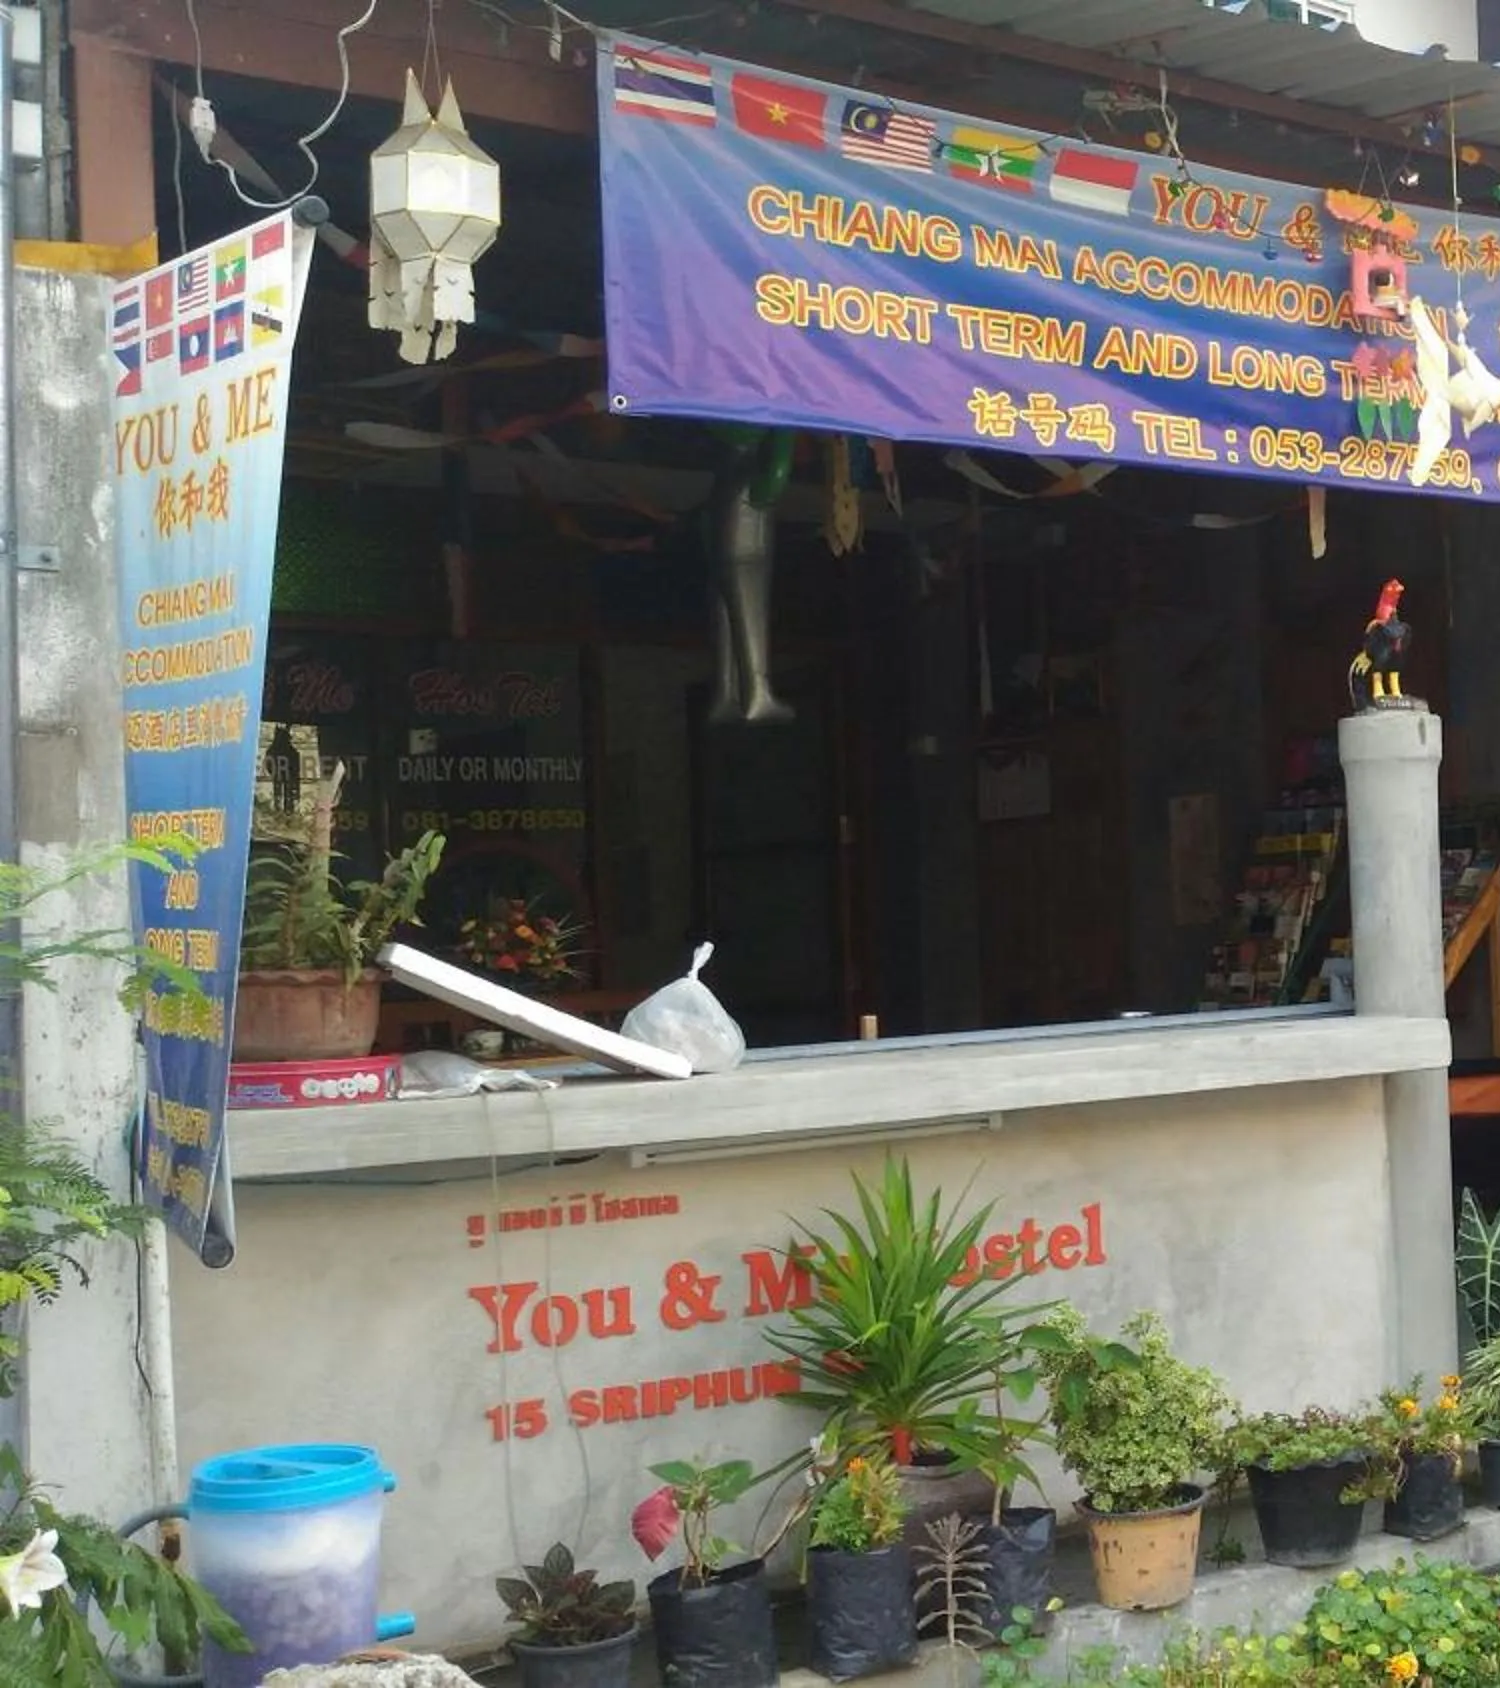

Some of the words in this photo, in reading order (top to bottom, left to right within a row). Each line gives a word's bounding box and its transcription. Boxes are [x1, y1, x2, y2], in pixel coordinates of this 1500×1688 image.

[748, 184, 962, 263] CHIANG
[970, 225, 1062, 280] MAI
[1151, 175, 1269, 241] YOU
[755, 273, 938, 343] SHORT
[947, 304, 1086, 367] TERM
[1094, 327, 1199, 379] AND
[1208, 342, 1326, 397] LONG
[114, 402, 179, 477] YOU
[191, 391, 212, 456] &
[224, 366, 277, 444] ME
[968, 387, 1115, 452] 话号码
[154, 455, 230, 540] 你和我
[398, 754, 455, 784] DAILY
[462, 755, 488, 782] OR
[493, 754, 585, 782] MONTHLY
[468, 1280, 637, 1354] You
[659, 1259, 727, 1331] &
[741, 1245, 850, 1317] M
[485, 1399, 548, 1443] 15
